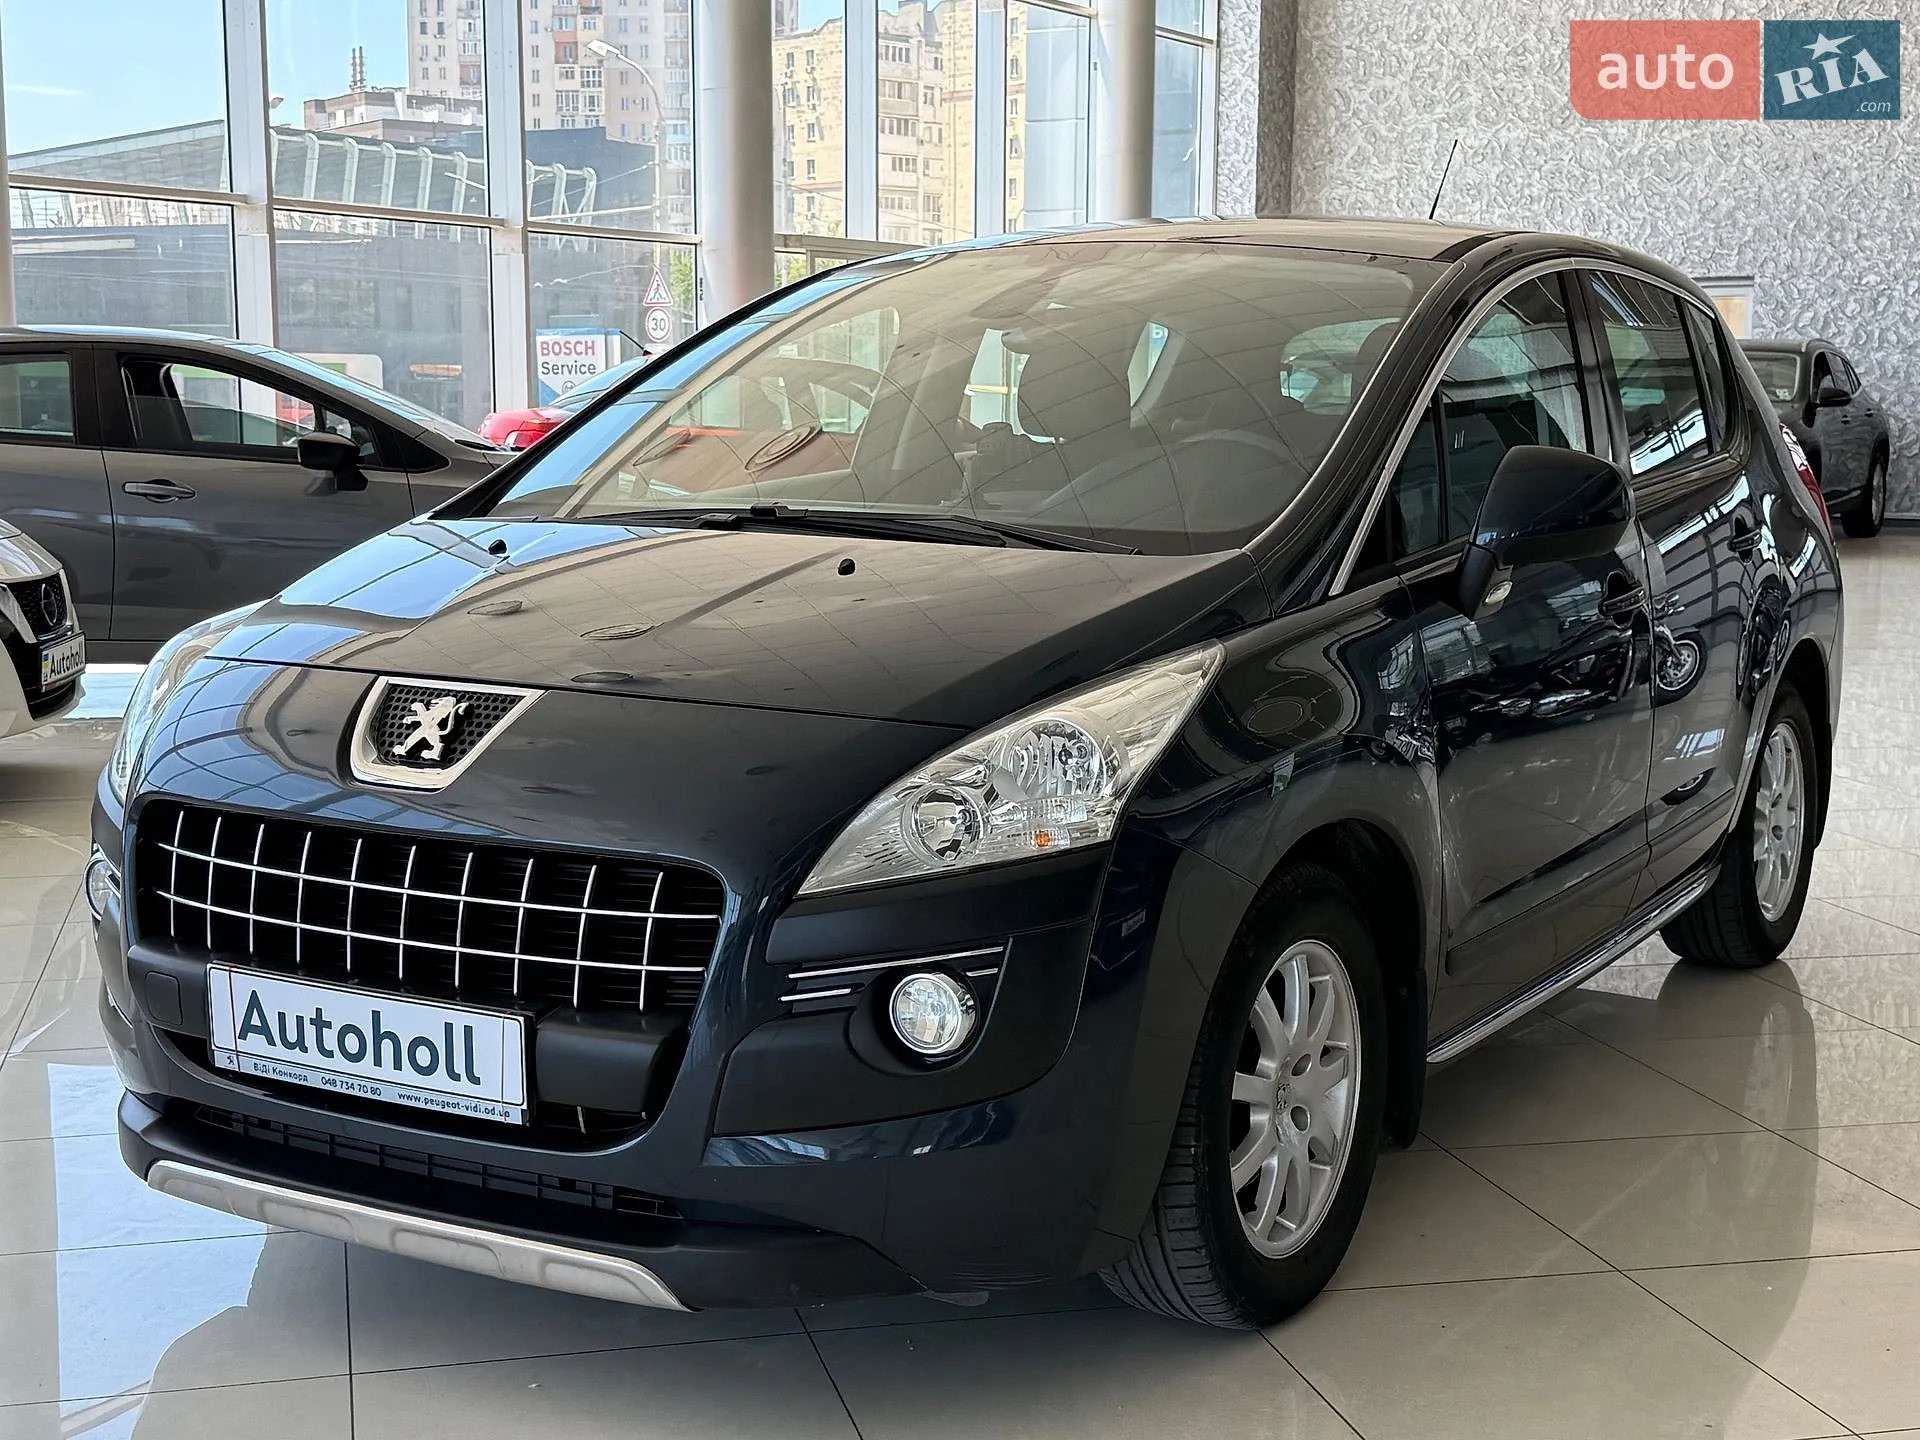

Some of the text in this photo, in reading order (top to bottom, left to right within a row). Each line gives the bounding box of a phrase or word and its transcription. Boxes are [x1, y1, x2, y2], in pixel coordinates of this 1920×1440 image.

[651, 317, 666, 332] 30
[540, 340, 596, 357] BOSCH
[541, 361, 597, 375] Service
[237, 989, 482, 1086] Autoholl
[272, 1066, 309, 1083] Конкорд
[320, 1076, 337, 1088] 048
[339, 1080, 356, 1091] 734
[358, 1083, 369, 1094] 70
[370, 1086, 382, 1097] 80
